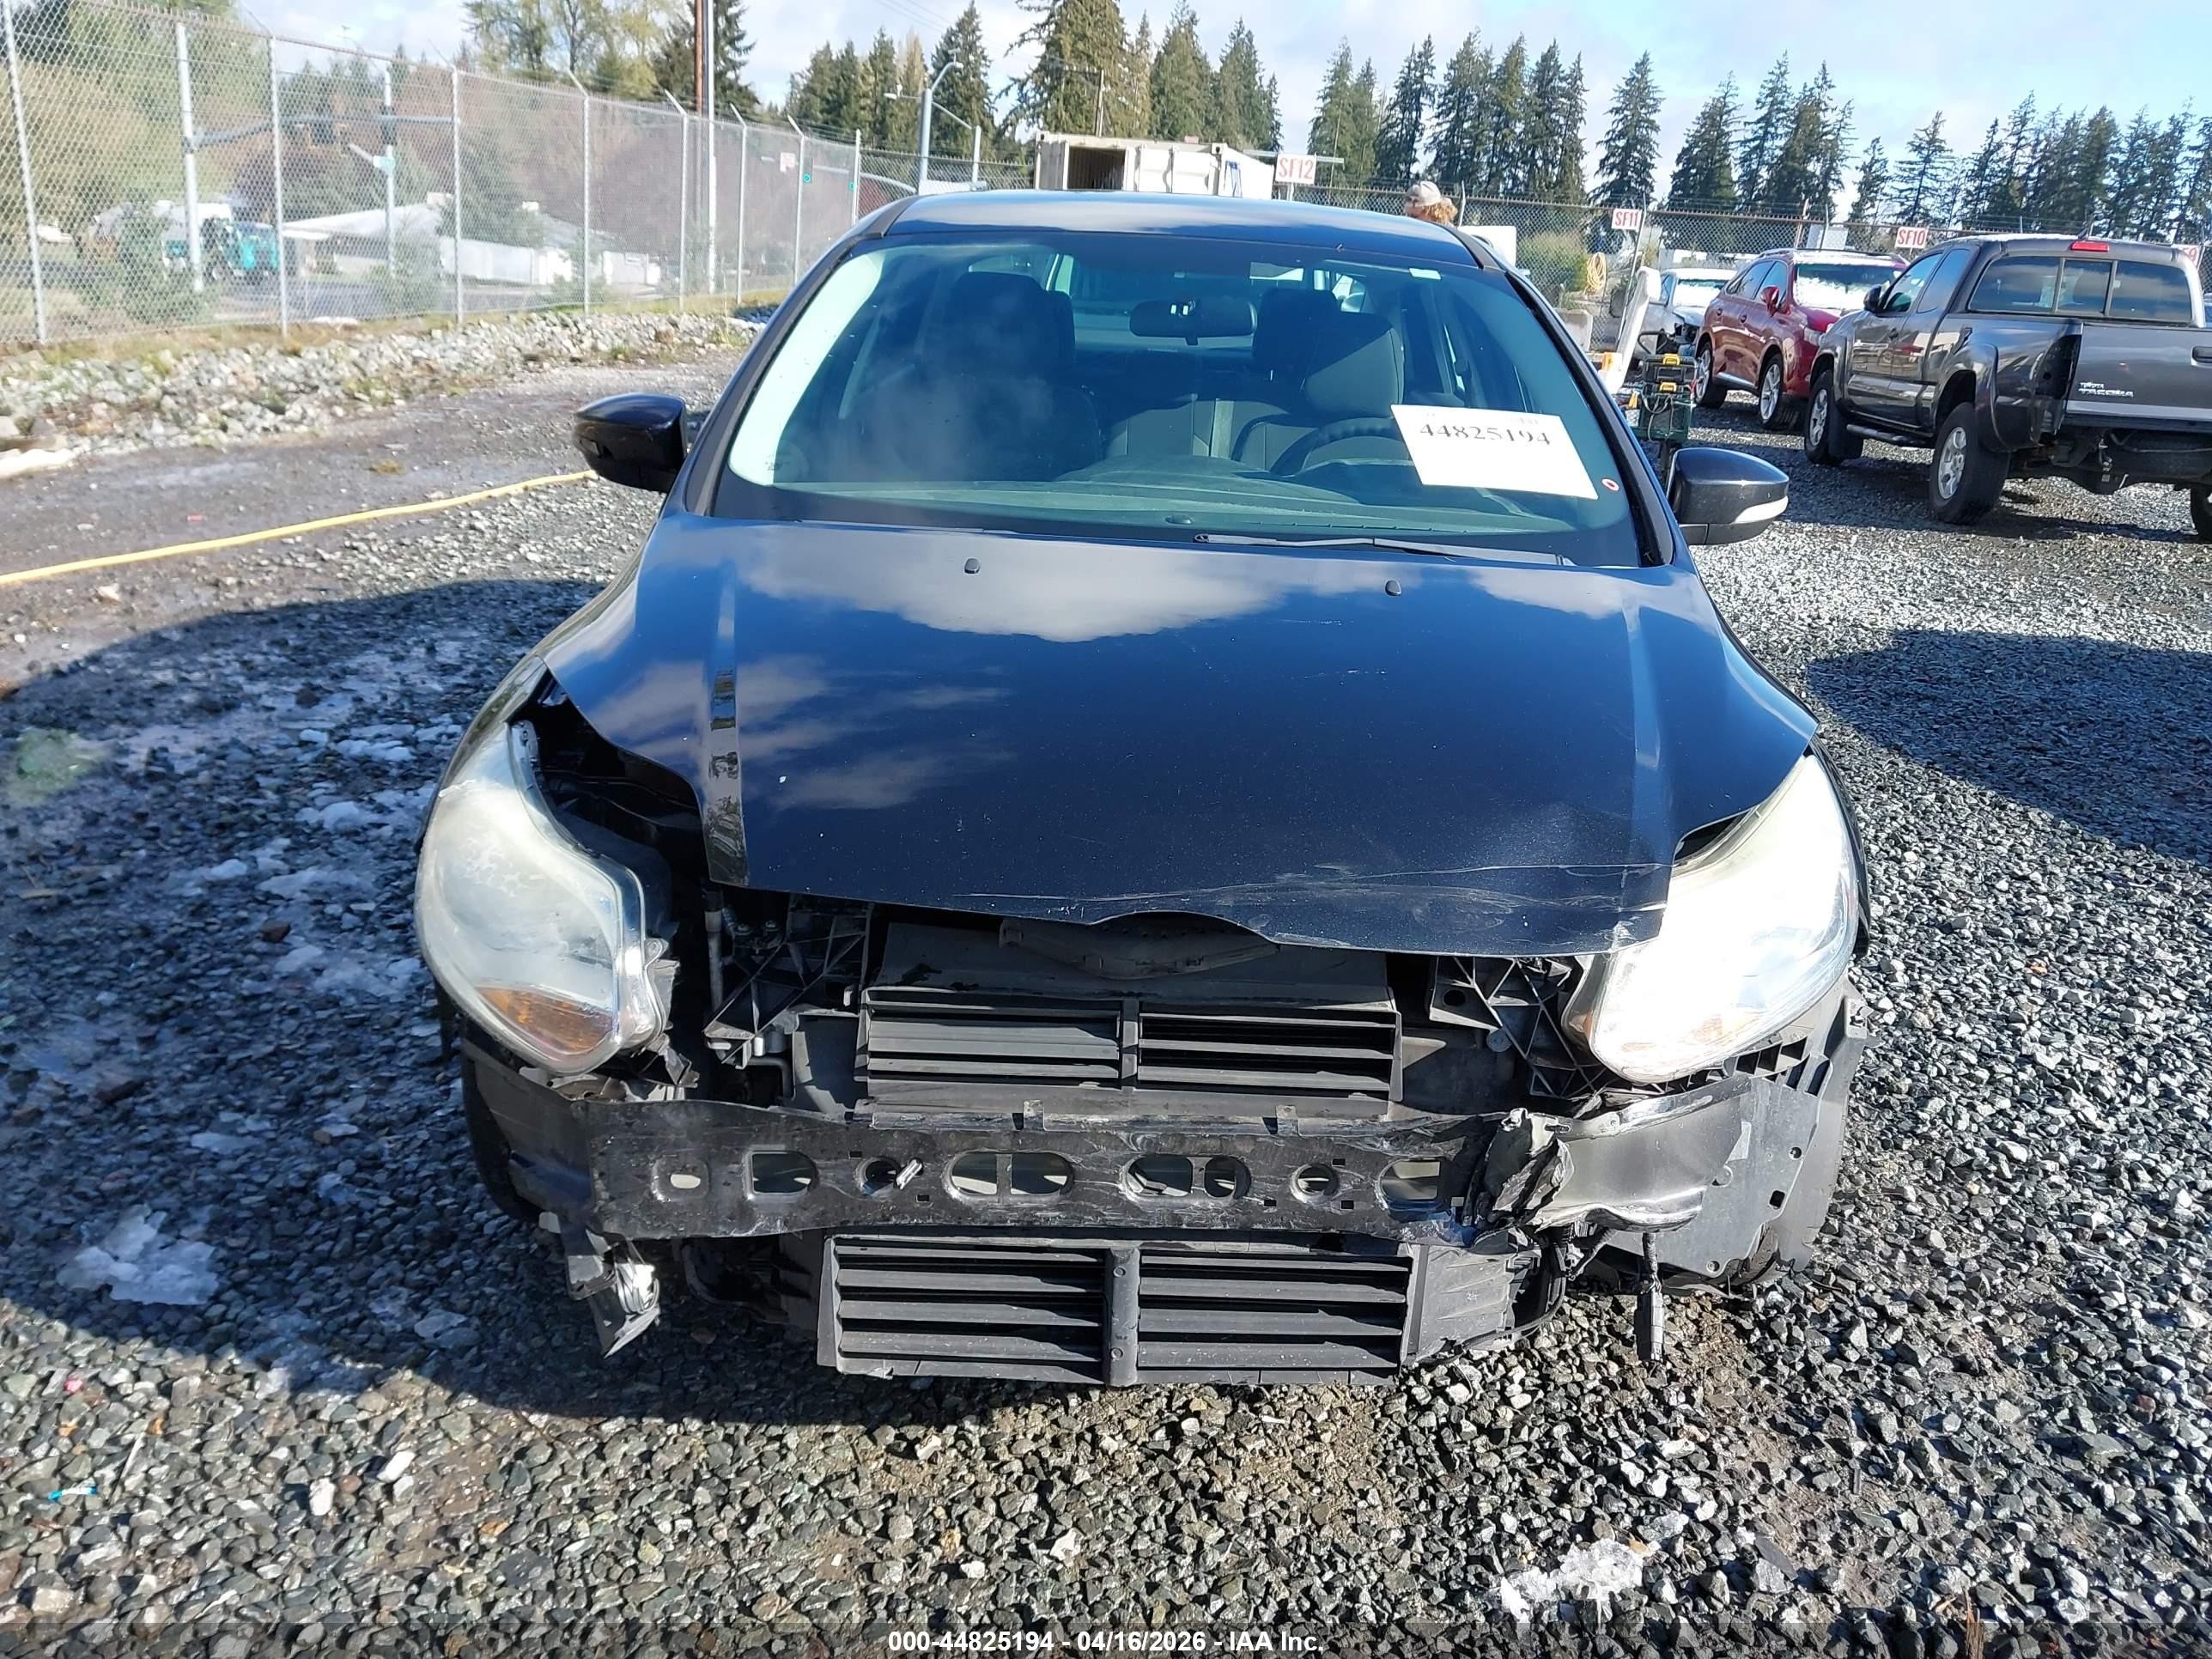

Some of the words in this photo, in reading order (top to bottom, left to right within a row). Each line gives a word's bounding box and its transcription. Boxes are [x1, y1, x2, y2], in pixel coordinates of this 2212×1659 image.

[1279, 157, 1314, 179] SF12
[1615, 211, 1638, 227] SF11
[1898, 229, 1926, 246] SF10
[2078, 388, 2134, 398] TACOMA
[1419, 424, 1550, 445] 44825194
